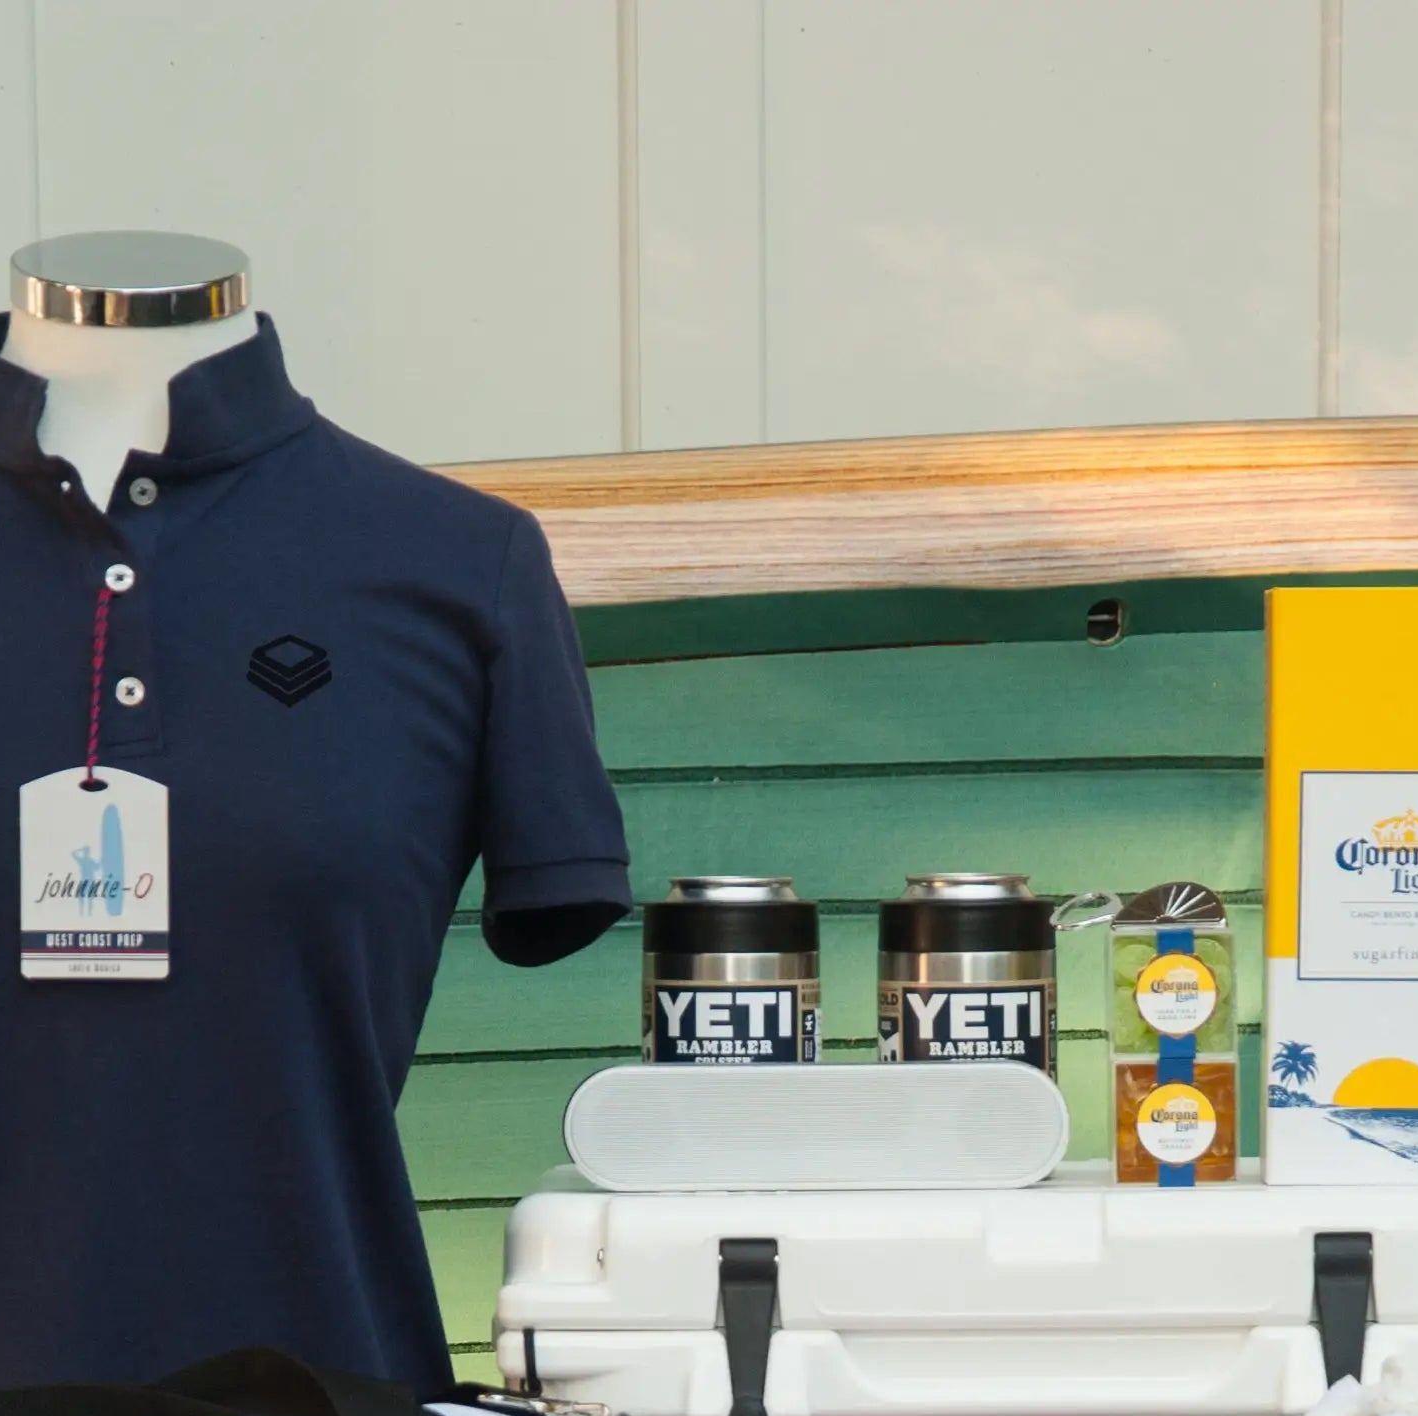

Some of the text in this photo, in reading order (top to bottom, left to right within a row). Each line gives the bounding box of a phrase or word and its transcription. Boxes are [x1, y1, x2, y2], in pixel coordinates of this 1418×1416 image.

[34, 872, 154, 904] johnnie-O
[45, 932, 144, 948] WEST COAST PREP
[1150, 979, 1199, 994] Corona
[657, 990, 793, 1038] YETI
[906, 990, 1043, 1040] YETI
[676, 1039, 774, 1055] RAMBLER
[928, 1039, 1026, 1057] RAMBLER
